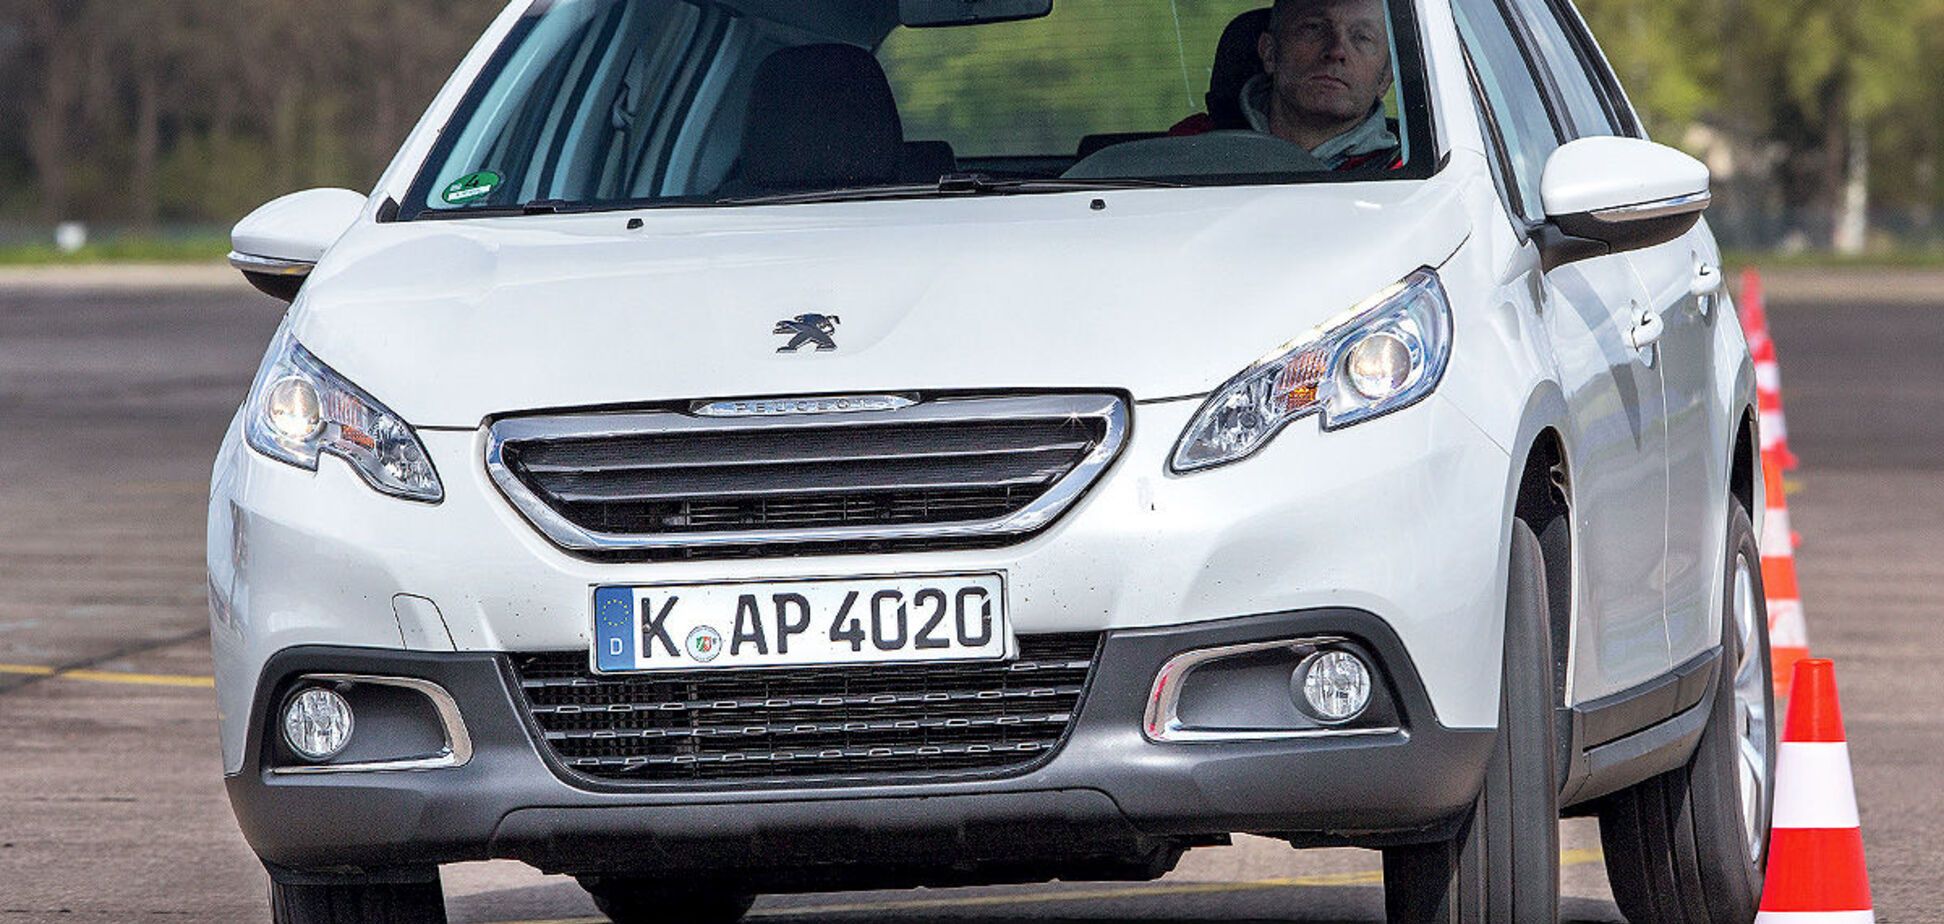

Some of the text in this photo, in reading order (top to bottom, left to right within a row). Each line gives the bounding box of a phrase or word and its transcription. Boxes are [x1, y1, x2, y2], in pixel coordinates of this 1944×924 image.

[465, 174, 480, 188] 4
[641, 585, 993, 658] K AP 4020
[608, 637, 623, 656] D
